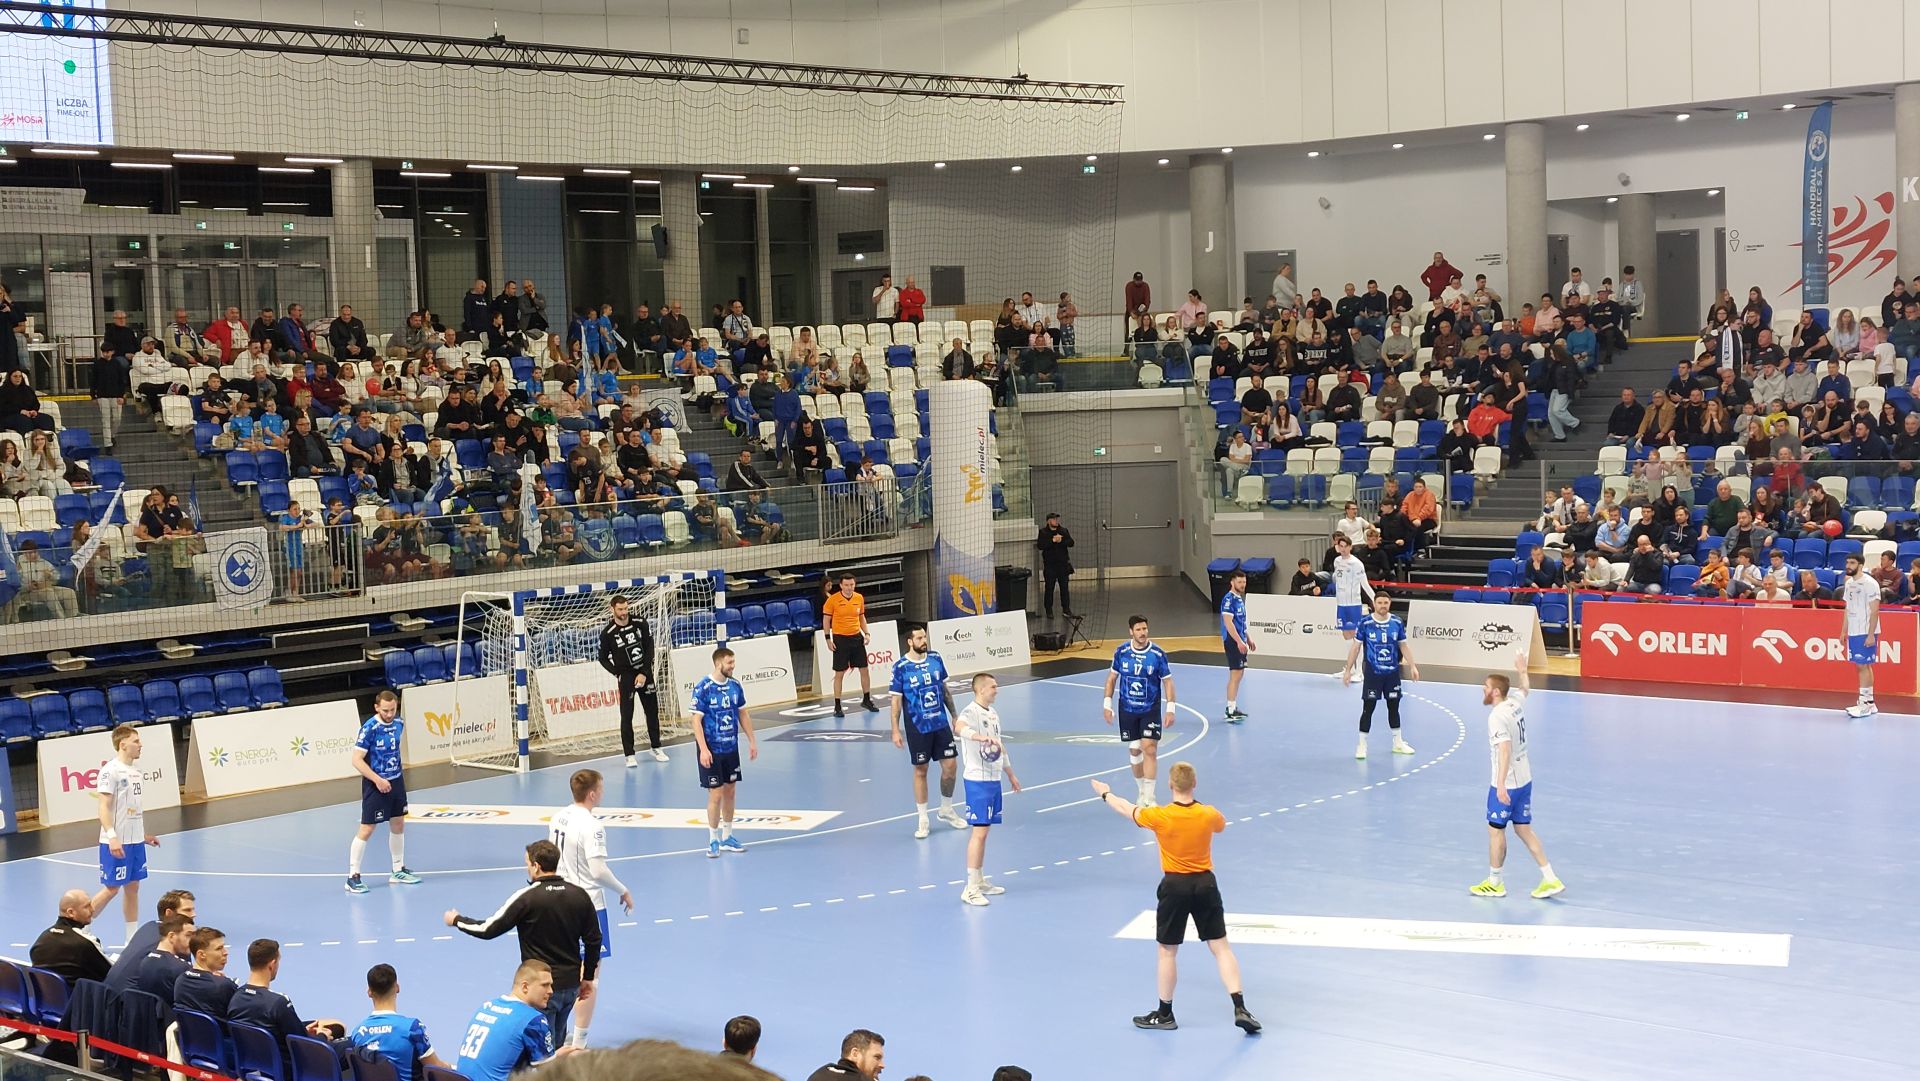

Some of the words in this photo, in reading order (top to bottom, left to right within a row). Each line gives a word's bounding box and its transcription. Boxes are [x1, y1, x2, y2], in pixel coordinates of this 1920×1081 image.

[56, 98, 88, 108] LICZBA
[1809, 166, 1817, 226] HANDBALL
[1903, 176, 1920, 203] K
[1816, 189, 1824, 227] MIELEC
[1205, 231, 1213, 253] J
[977, 427, 985, 473] mielec.pl
[1426, 626, 1464, 638] REGMOT
[1472, 631, 1491, 640] REG
[1492, 632, 1523, 641] TRUCK
[1638, 630, 1728, 656] ORLEN
[1804, 636, 1901, 664] ORN
[866, 650, 893, 665] OSiR
[741, 674, 753, 682] PZL
[755, 669, 779, 679] MIELEC
[1134, 663, 1142, 675] 17
[922, 672, 932, 685] 19
[721, 696, 731, 709] 43
[454, 718, 497, 736] mielec.pl
[390, 737, 396, 750] 3
[235, 747, 278, 761] ENERGIA
[133, 782, 142, 795] 28
[554, 829, 566, 859] 11
[115, 865, 127, 881] 28
[368, 1025, 393, 1034] ORLEN
[459, 1023, 490, 1060] 33
